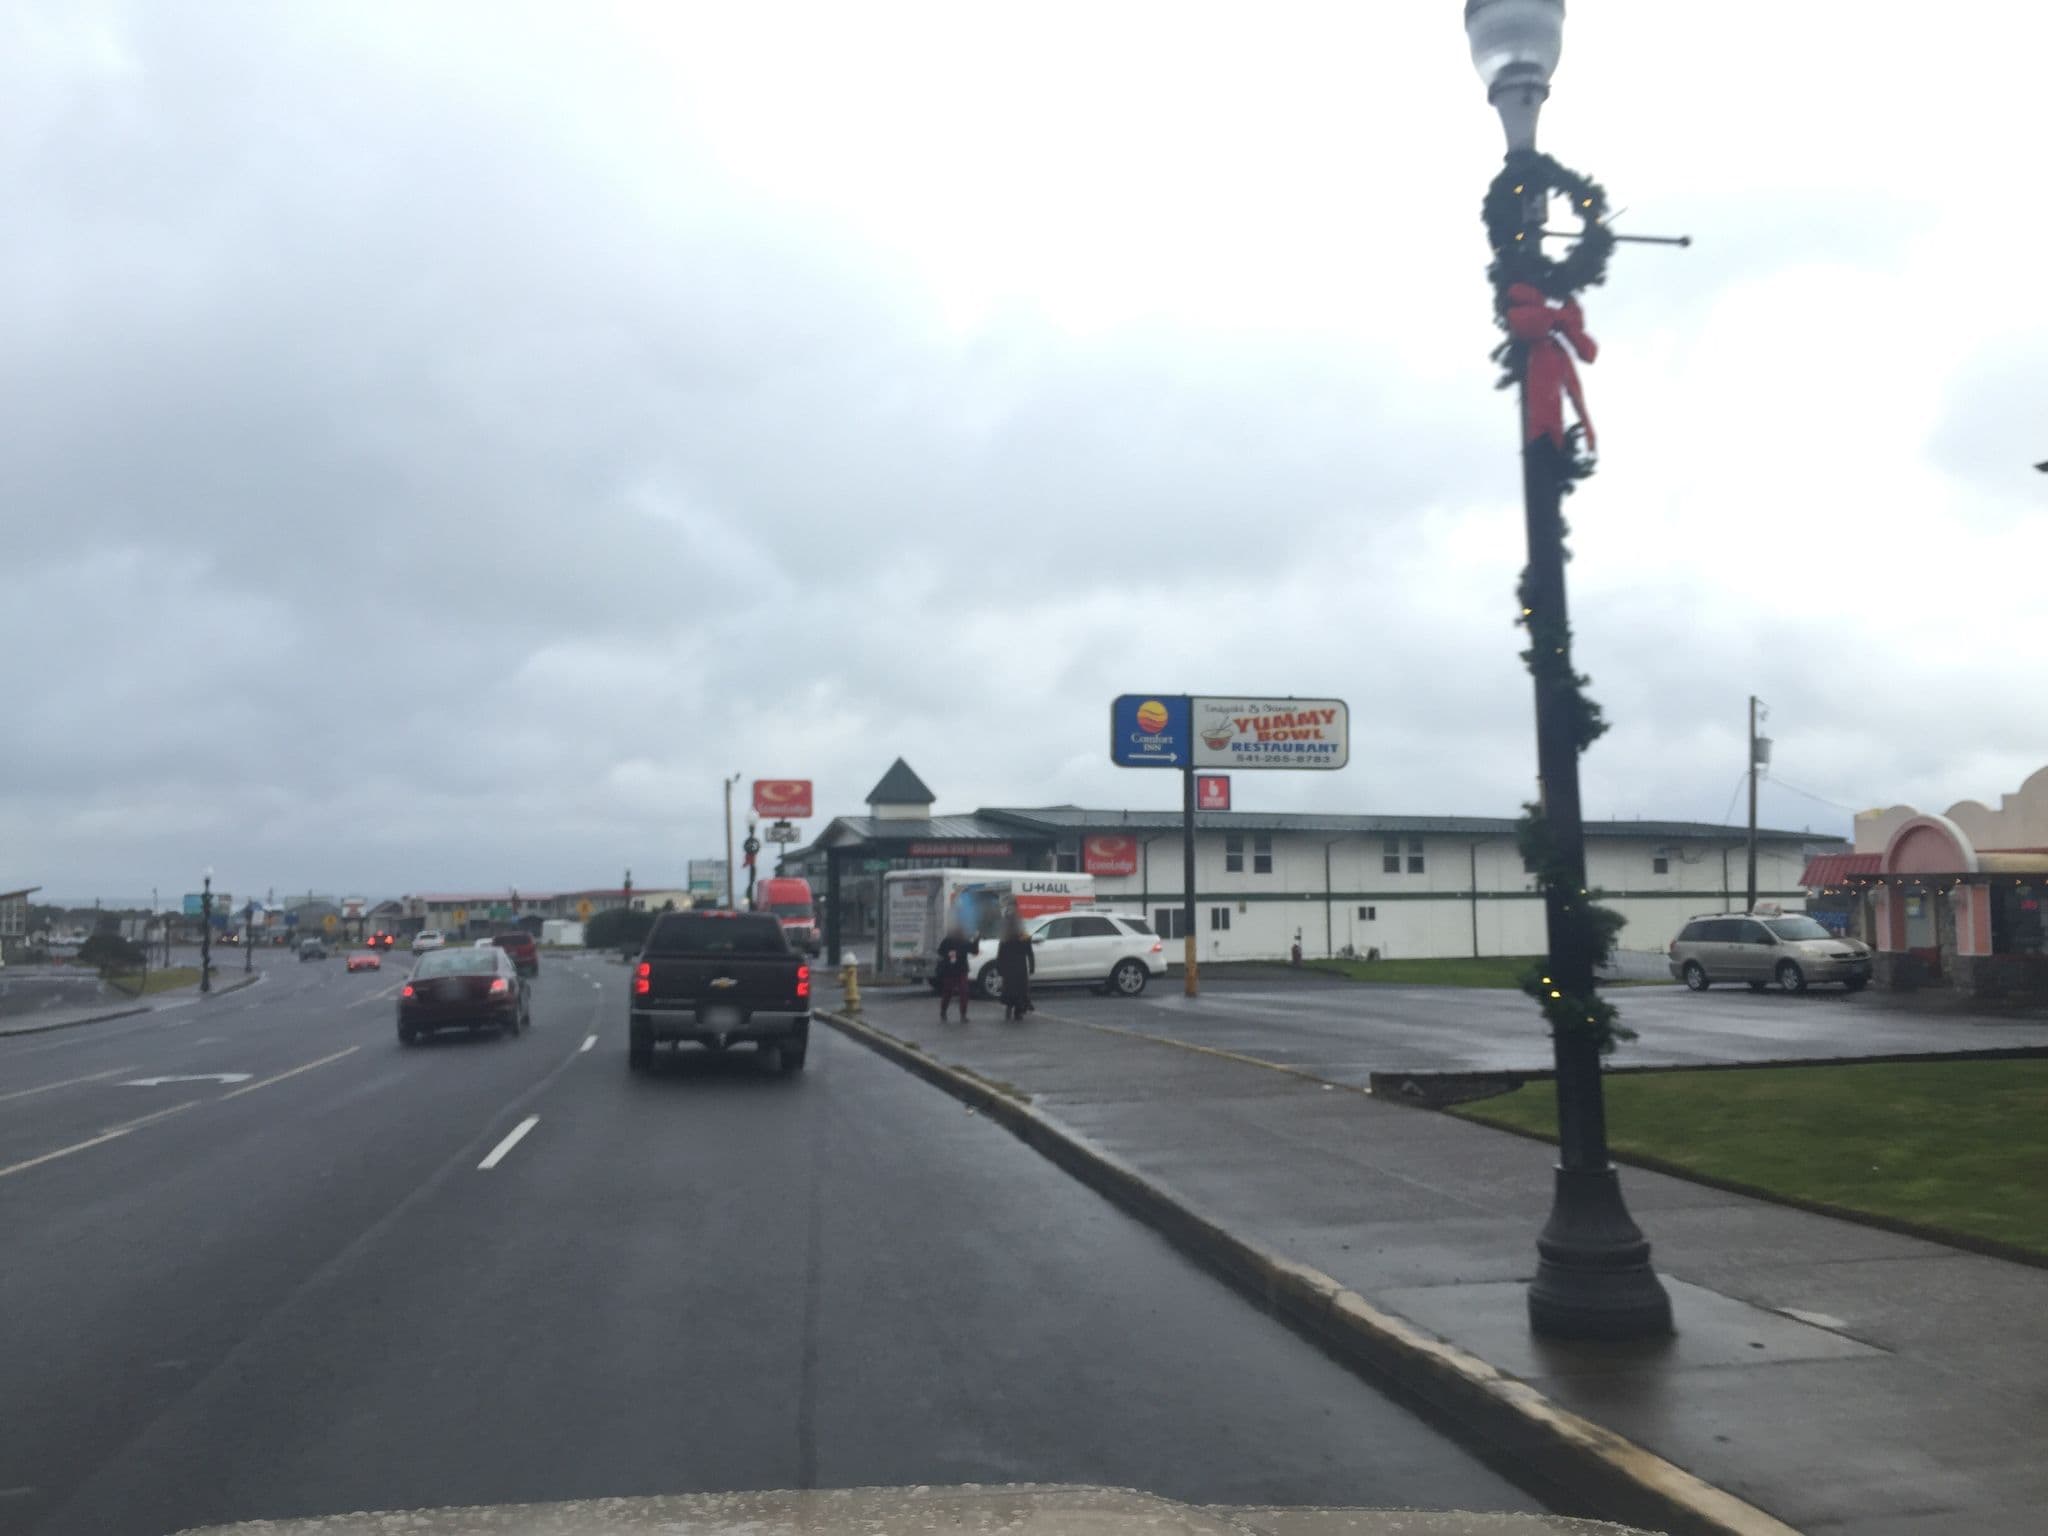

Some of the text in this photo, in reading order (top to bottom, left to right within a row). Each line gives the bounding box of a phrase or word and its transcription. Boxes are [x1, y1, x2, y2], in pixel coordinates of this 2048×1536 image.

[1233, 709, 1337, 733] YUMMY
[1130, 733, 1174, 745] Comfort
[1256, 728, 1325, 742] BOWL
[1231, 742, 1339, 753] RESTAURANT
[1022, 882, 1071, 894] U-HAUL
